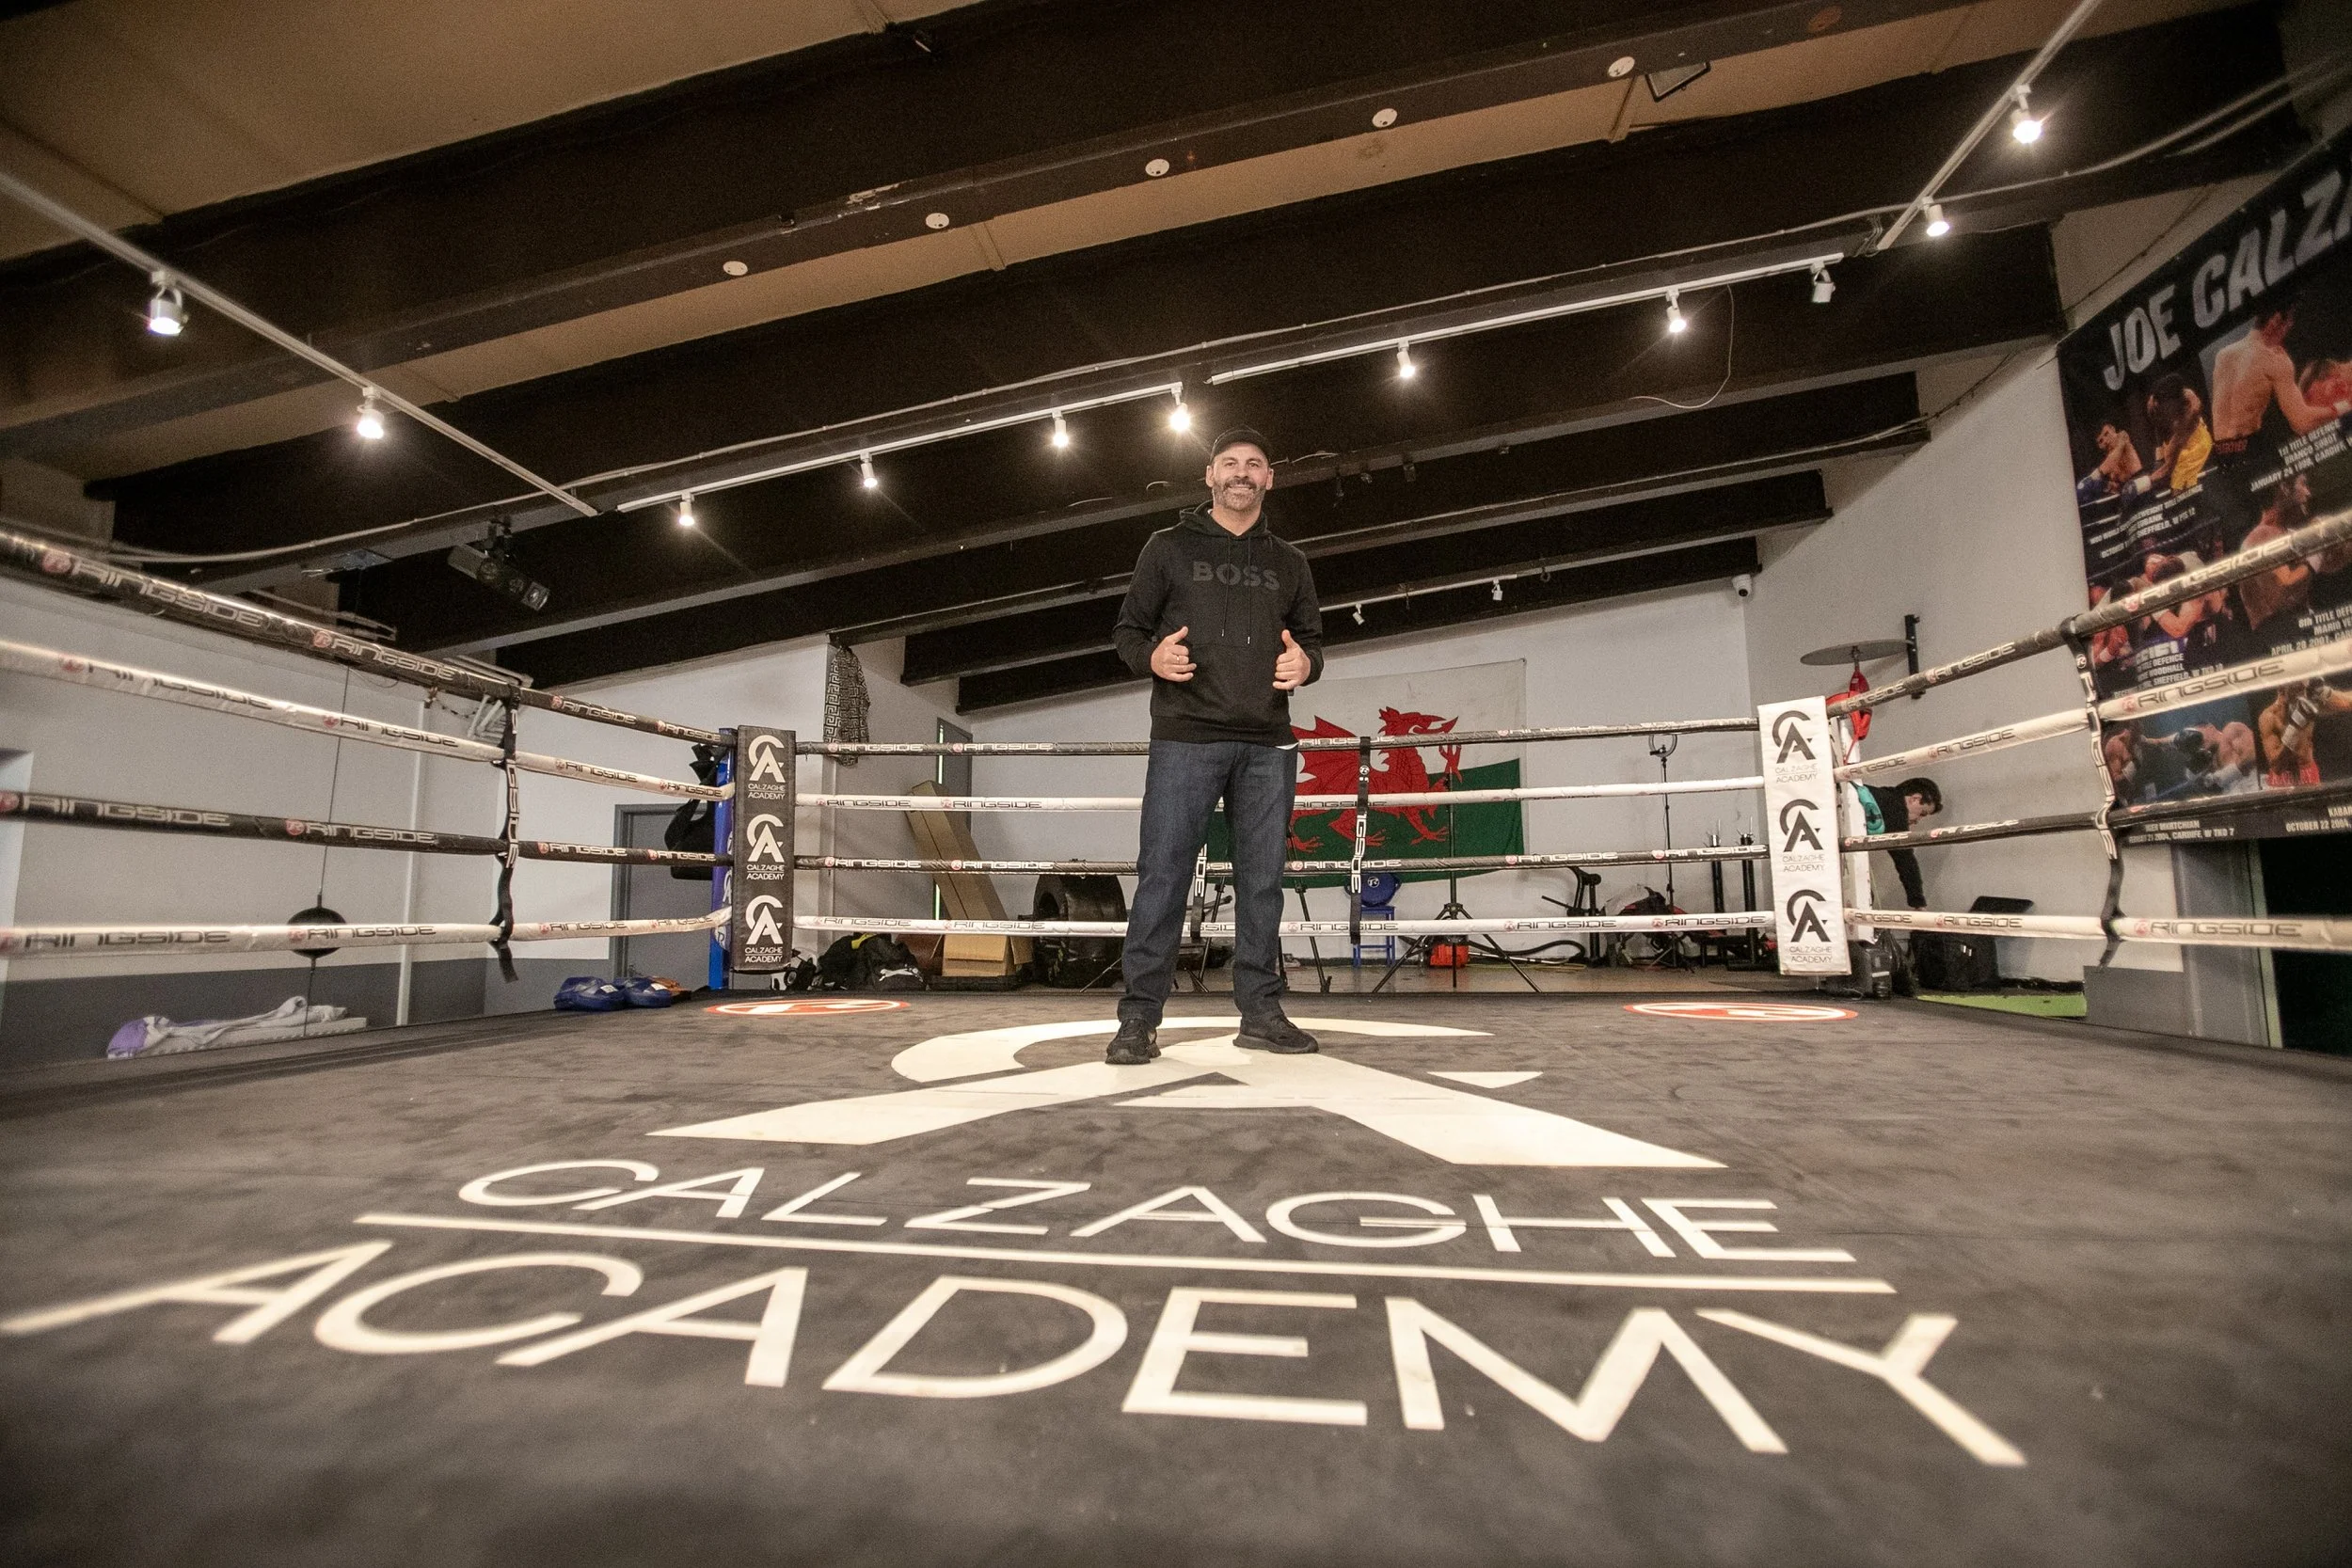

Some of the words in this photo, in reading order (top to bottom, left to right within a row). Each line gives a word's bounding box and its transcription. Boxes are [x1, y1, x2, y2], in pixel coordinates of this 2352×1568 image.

[2104, 285, 2182, 390] JOE
[2250, 471, 2281, 492] JANUARY
[1192, 561, 1281, 591] BOSS
[71, 565, 265, 628] RINGSIDE
[2314, 610, 2335, 625] TITLE
[2313, 621, 2342, 636] MARIO
[330, 631, 455, 681] RINGSIDE
[2271, 643, 2293, 657] APRIL
[1936, 641, 2016, 680] RINGSIDE
[2153, 653, 2184, 666] DEFENCE
[2137, 660, 2285, 708] RINGSIDE
[561, 699, 638, 727] RINGSIDE
[666, 723, 722, 742] RINGSIDE
[837, 743, 924, 752] RINGSIDE
[963, 742, 1054, 752] RINGSIDE
[1936, 728, 2015, 754] RINGSIDE
[565, 760, 639, 783] RINGSIDE
[1775, 773, 1818, 784] ACADEMY
[666, 780, 723, 797] RINGSIDE
[748, 783, 785, 791] CALZAGHE
[22, 792, 231, 827] RINGSIDE
[827, 800, 912, 808] RINGSIDE
[952, 800, 1042, 809] RINGSIDE
[2285, 819, 2319, 832] OCTOBER
[305, 823, 438, 845] RINGSIDE
[550, 841, 628, 858] RINGSIDE
[658, 850, 717, 862] RINGSIDE
[1665, 845, 1767, 856] RINGSIDE
[834, 859, 922, 869] RINGSIDE
[1518, 852, 1618, 863] RINGSIDE
[961, 861, 1054, 870] RINGSIDE
[1783, 863, 1825, 873] ACADEMY
[823, 917, 913, 927] RINGSIDE
[1664, 916, 1766, 927] RINGSIDE
[1854, 911, 1913, 924] RINGSIDE
[1943, 916, 2023, 927] RINGSIDE
[548, 920, 627, 932] RINGSIDE
[953, 921, 1046, 930] RINGSIDE
[1517, 920, 1617, 929] RINGSIDE
[2150, 921, 2303, 937] RINGSIDE
[24, 929, 232, 948] RINGSIDE
[307, 925, 437, 940] RINGSIDE
[745, 946, 783, 955] CALZAGHE
[745, 955, 783, 963] ACADEMY
[1790, 955, 1833, 964] ACADEMY
[459, 1159, 1857, 1263] CALZAGHE
[0, 1240, 2027, 1468] ACADEMY
